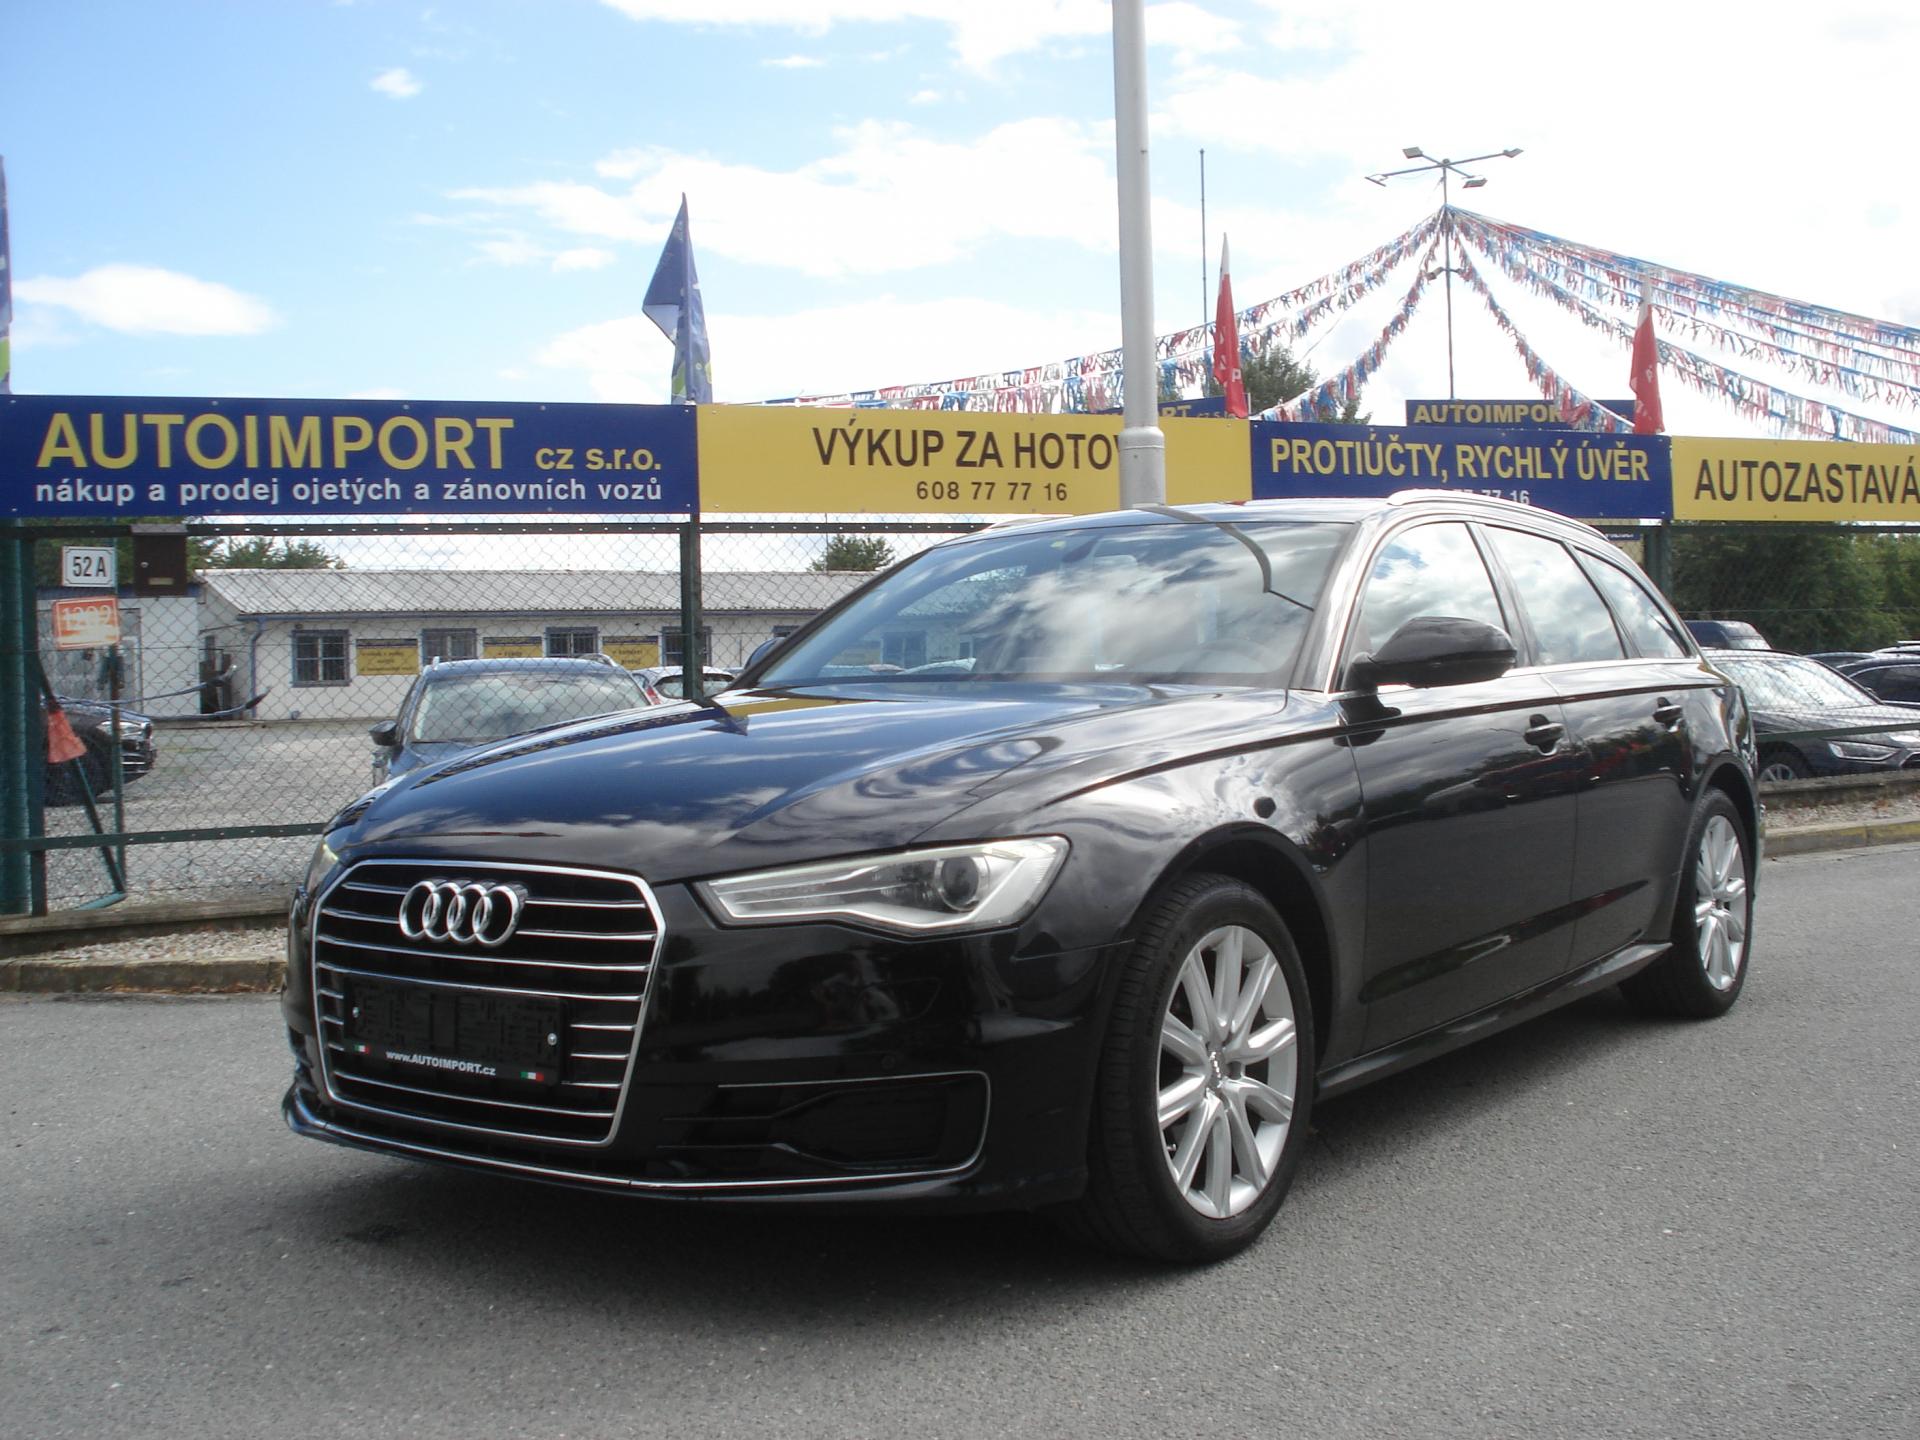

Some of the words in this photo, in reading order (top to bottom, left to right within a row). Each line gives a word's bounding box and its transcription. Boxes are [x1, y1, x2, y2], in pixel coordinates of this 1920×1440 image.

[1414, 404, 1568, 423] AUTOIMPOR
[36, 413, 514, 469] AUTOIMPORT
[536, 448, 574, 470] cz
[585, 448, 661, 470] s.r.o.
[813, 419, 944, 467] VÝKUP
[956, 430, 1004, 468] ZA
[1271, 434, 1448, 483] PROTIÚČTY,
[1456, 439, 1569, 480] RYCHLÝ
[1576, 440, 1650, 481] ÚVĚR
[36, 479, 135, 506] nákup
[148, 484, 165, 501] a
[180, 478, 279, 505] prodej
[292, 477, 400, 505] ojetých
[414, 483, 430, 500] a
[443, 478, 586, 500] zánovních
[598, 477, 661, 500] vozů
[916, 481, 960, 500] 608
[971, 482, 996, 500] 77
[1007, 482, 1032, 500] 77
[1044, 482, 1067, 501] 16
[1694, 456, 1920, 504] AUTOZASTAVÁ
[1509, 489, 1530, 505] 16
[73, 556, 92, 577] 52
[95, 556, 107, 577] A
[385, 1051, 497, 1076] www.AUTOIMPORT.cz
